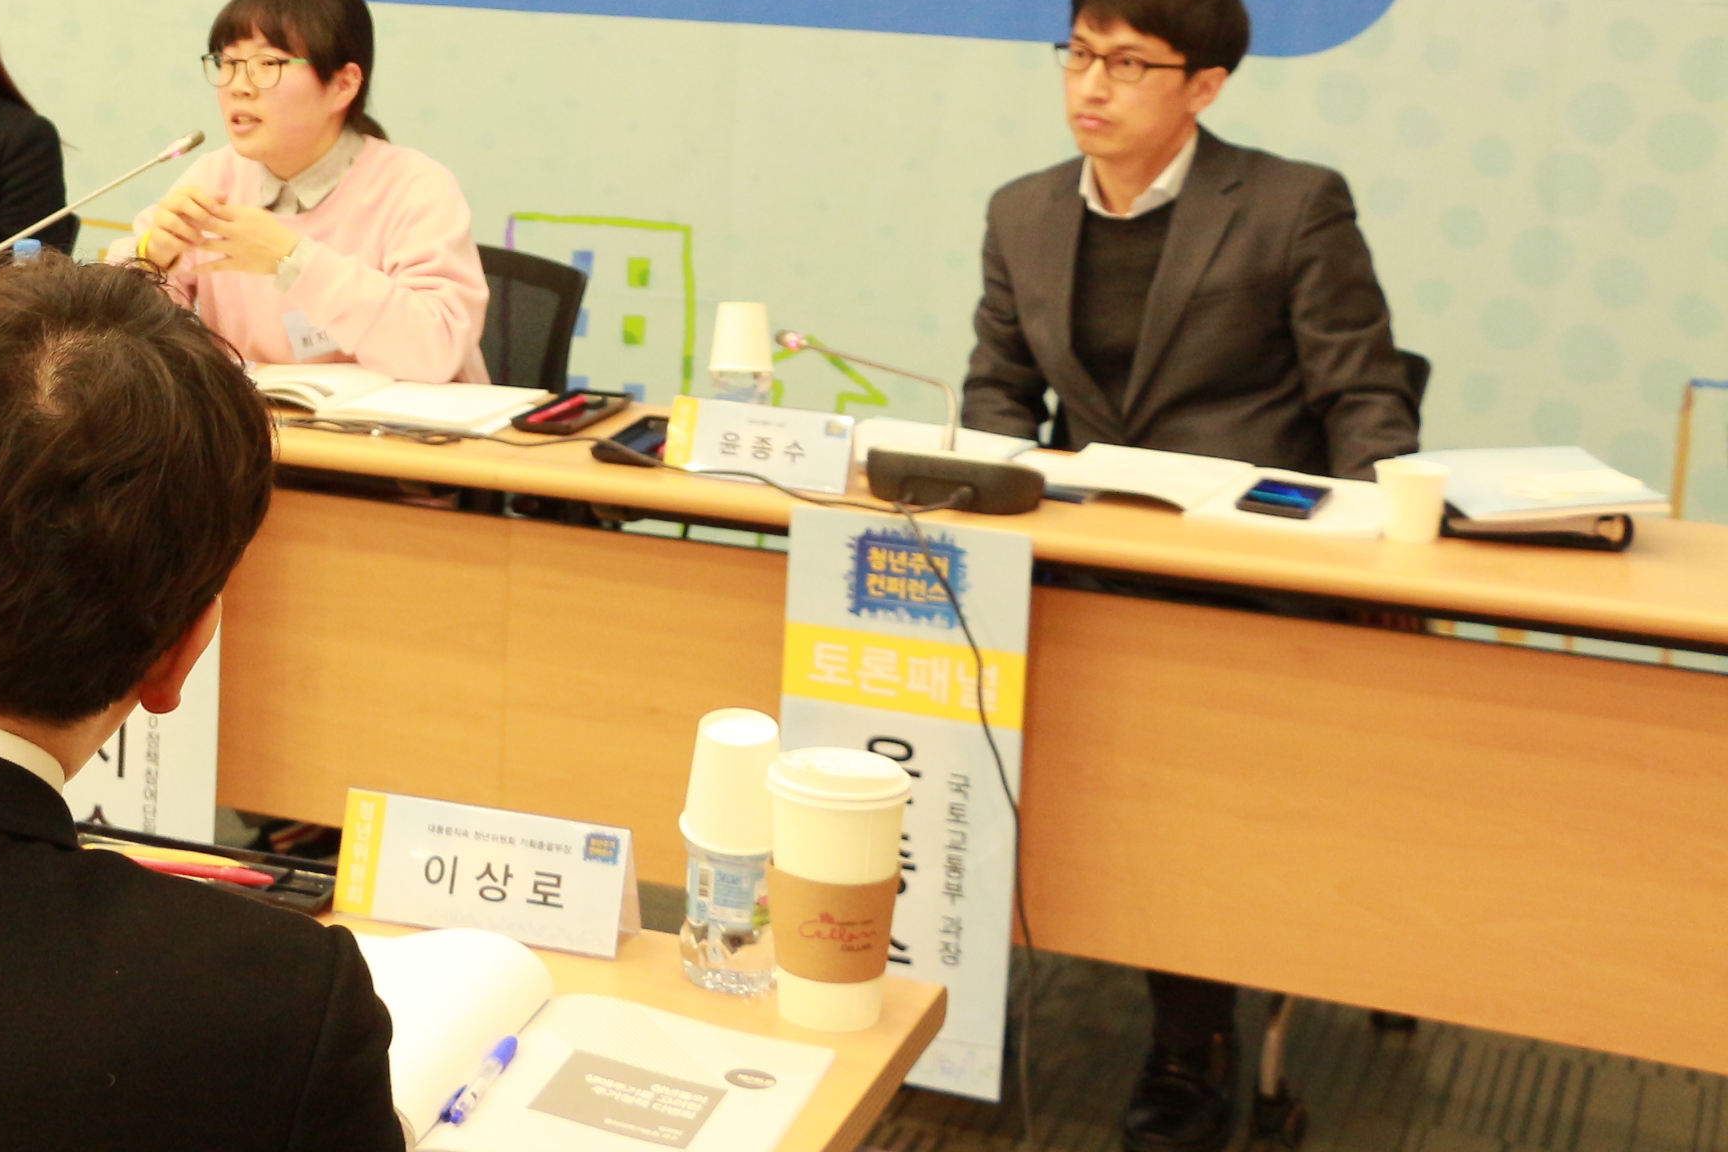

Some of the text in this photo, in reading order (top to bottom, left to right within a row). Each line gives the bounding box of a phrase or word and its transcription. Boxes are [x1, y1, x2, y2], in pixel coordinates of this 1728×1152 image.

[865, 572, 949, 603] 컨퍼런스
[867, 545, 951, 580] 청년주거
[807, 639, 1000, 714] 토론패널
[942, 772, 972, 906] 국토교통부
[423, 854, 565, 909] 이상로
